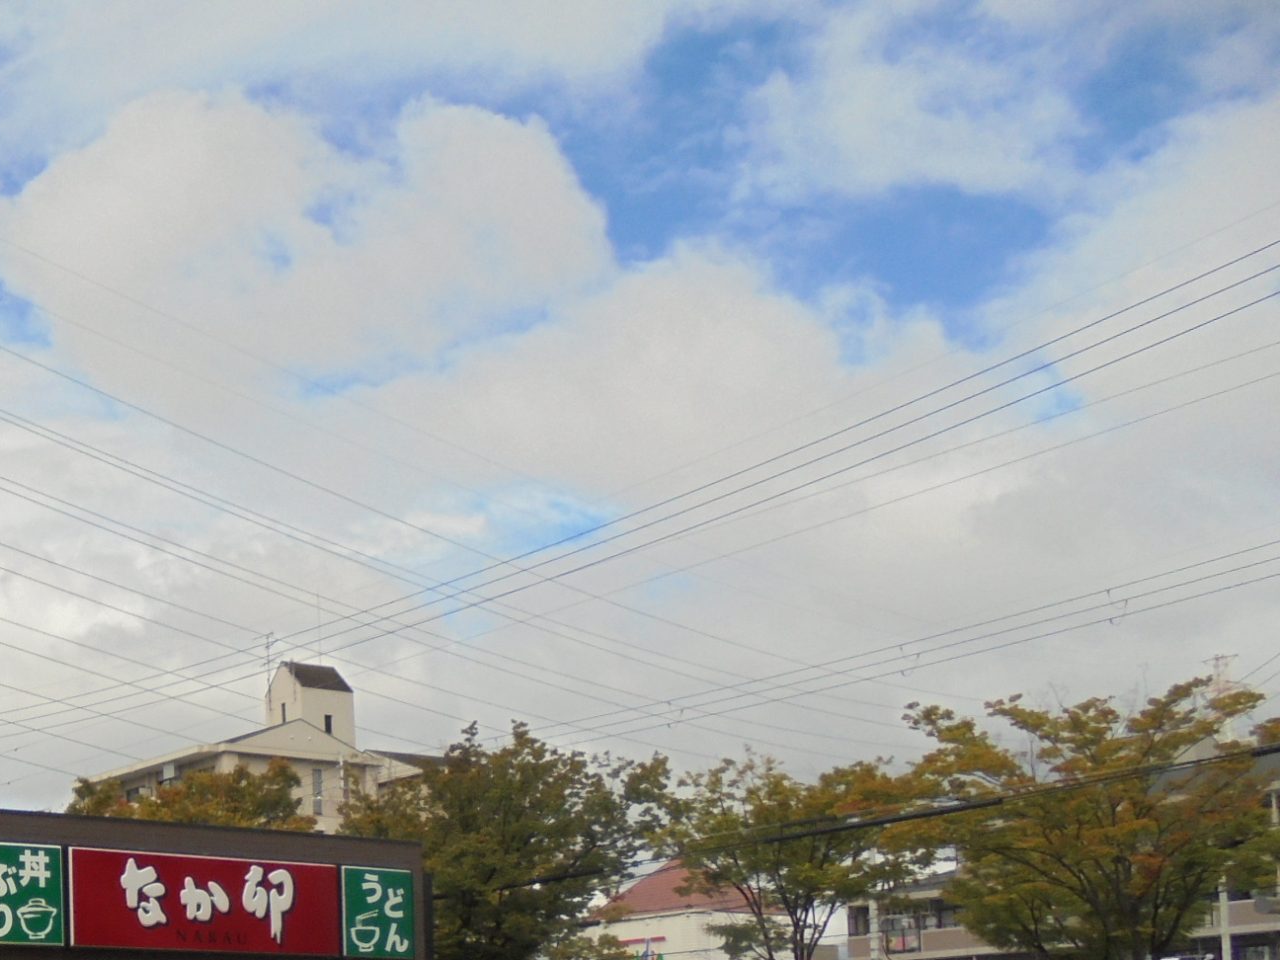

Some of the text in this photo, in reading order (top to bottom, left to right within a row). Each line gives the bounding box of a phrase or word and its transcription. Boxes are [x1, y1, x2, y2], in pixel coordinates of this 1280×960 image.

[120, 857, 294, 944] なか卯
[361, 873, 409, 953] うどん
